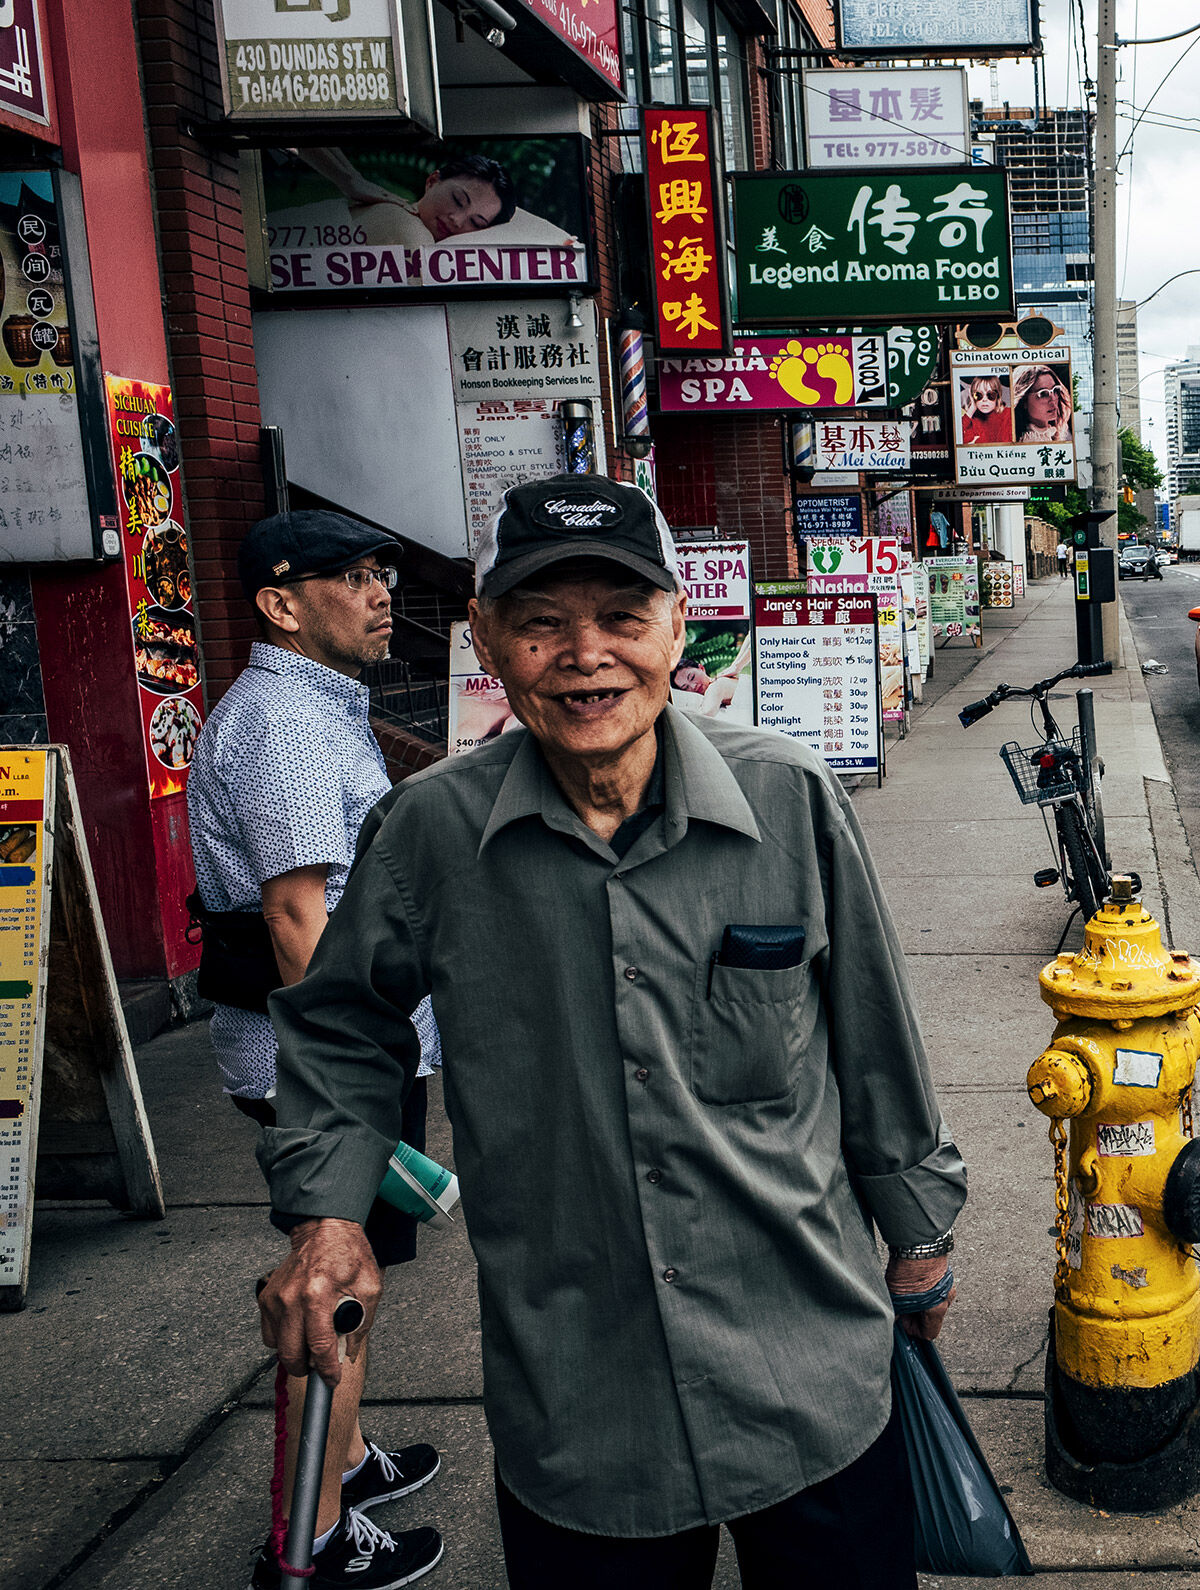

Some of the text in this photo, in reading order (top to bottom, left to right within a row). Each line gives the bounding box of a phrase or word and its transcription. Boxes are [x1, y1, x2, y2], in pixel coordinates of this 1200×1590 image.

[560, 2, 620, 82] 416-977-0988
[236, 42, 386, 71] 430 DUNDAS ST. W
[238, 73, 390, 103] Tel:416-260-8898
[829, 87, 944, 122] 基本髮
[824, 141, 950, 158] TEL: 977-5876
[755, 225, 835, 254] 美食
[847, 183, 993, 254] 传奇
[326, 250, 402, 287] SPA
[427, 248, 578, 283] CENTER
[749, 256, 999, 290] Legend Aroma Food
[22, 219, 56, 345] 民间瓦罐
[938, 284, 999, 301] LLBO
[496, 313, 551, 339] 漢誠
[460, 343, 590, 372] 會計服務社
[663, 346, 768, 373] NASHA
[858, 338, 880, 387] 428
[955, 349, 1065, 362] Chinatown Optical
[991, 366, 1009, 374] FENDI
[460, 375, 595, 390] Honson Bookkeeping Services Inc.
[681, 378, 753, 403] SPA
[113, 392, 157, 415] SICHUAN
[116, 418, 155, 439] CUISINE
[821, 425, 904, 453] 基本髮
[838, 453, 906, 467] Mei Salon
[467, 466, 506, 474] SHAMPOO
[989, 465, 1036, 477] Quang
[960, 490, 1004, 498] Department
[544, 500, 616, 514] Canadian
[797, 498, 849, 507] OPTOMETRIST
[561, 513, 602, 527] Club
[119, 445, 153, 636] 精美川菜
[812, 539, 845, 547] SPECIAL
[850, 539, 898, 575] $15
[704, 560, 747, 581] SPA
[778, 583, 800, 591] Legend
[811, 578, 865, 594] Nasha
[692, 607, 719, 616] Floor
[763, 597, 871, 612] Jane's Hair Salon
[760, 638, 777, 646] Only
[800, 637, 816, 645] Cut
[760, 650, 810, 659] Shampoo &
[777, 661, 807, 671] Styling
[760, 677, 795, 686] Shampoo
[796, 676, 822, 686] Styling
[760, 690, 783, 698] Perm
[849, 689, 868, 698] 30up
[760, 704, 784, 712] Color
[849, 702, 868, 711] 30up
[761, 716, 801, 726] Highlight
[849, 715, 868, 724] 25up
[850, 728, 868, 737] 10up
[850, 741, 869, 750] 70up
[855, 758, 864, 766] W.
